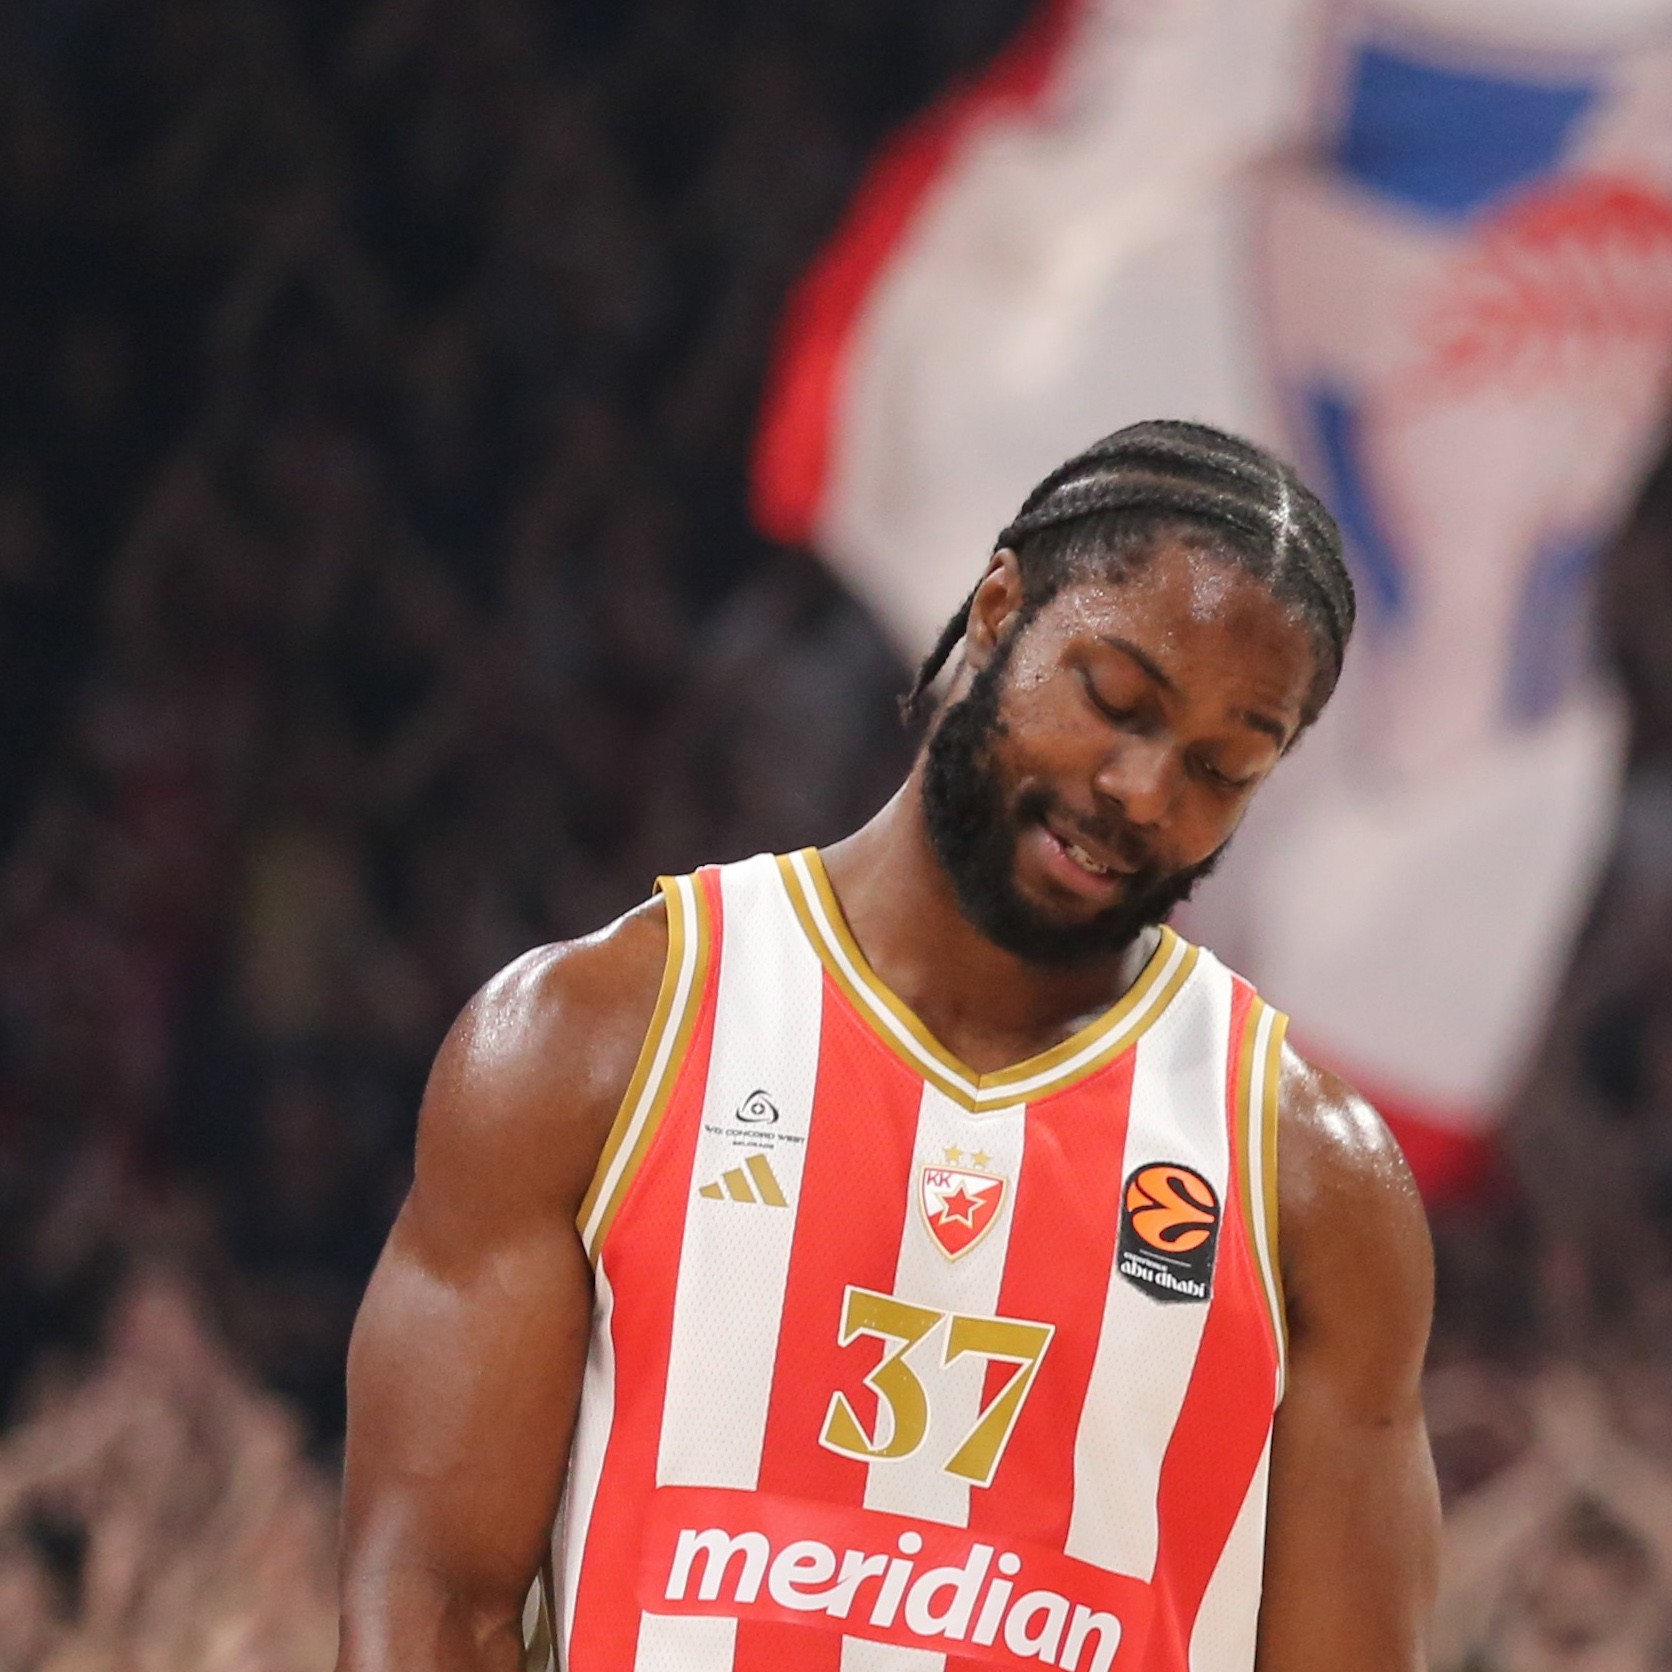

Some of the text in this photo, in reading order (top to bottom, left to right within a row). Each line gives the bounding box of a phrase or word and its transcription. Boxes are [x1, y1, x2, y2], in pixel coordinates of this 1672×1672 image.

[725, 1128, 776, 1140] CONCORD
[926, 1169, 952, 1188] KK
[1120, 1260, 1206, 1299] abu dhabi
[819, 1286, 1055, 1488] 37
